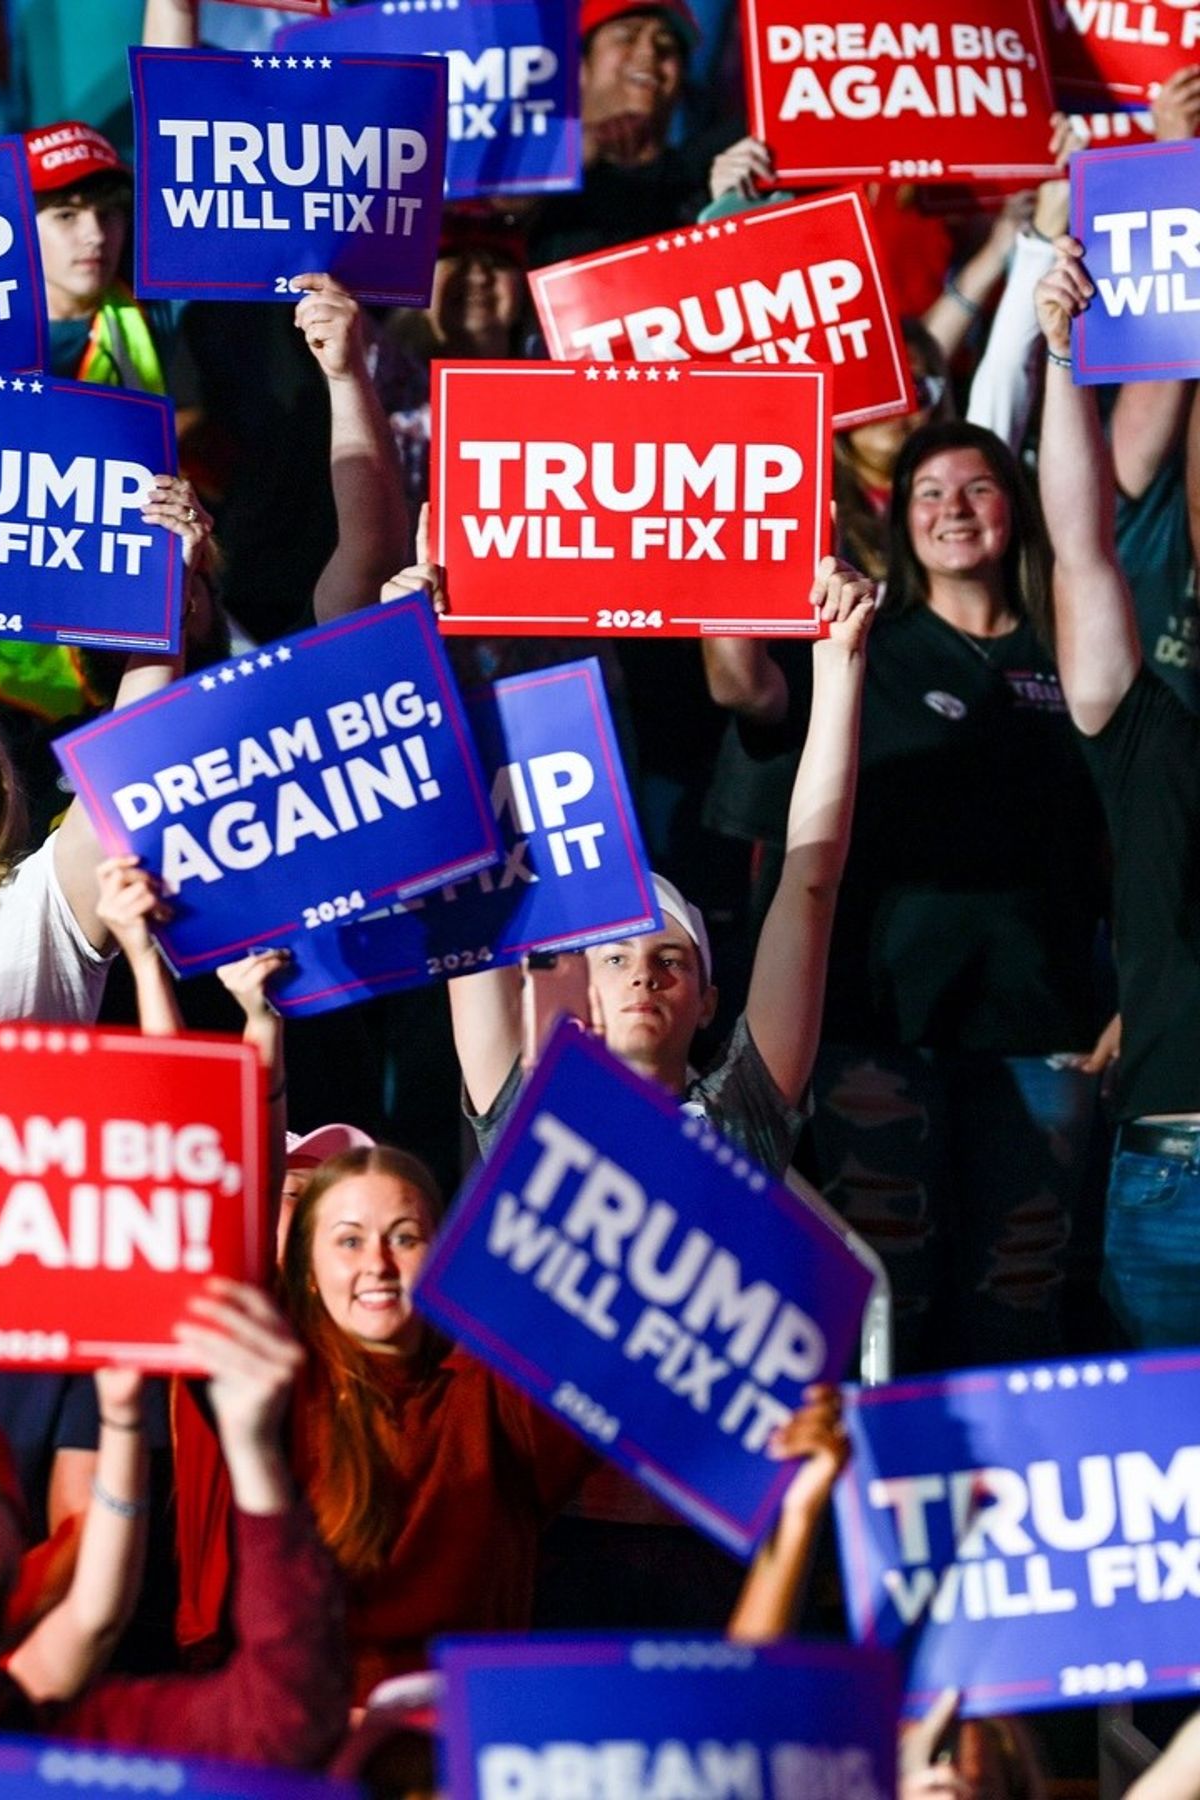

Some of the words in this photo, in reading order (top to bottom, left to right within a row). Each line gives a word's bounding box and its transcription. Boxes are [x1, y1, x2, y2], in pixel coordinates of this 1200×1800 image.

[767, 23, 942, 63] DREAM
[951, 26, 1038, 71] BIG,
[511, 99, 555, 136] IT
[779, 65, 1028, 121] AGAIN!
[158, 119, 428, 190] TRUMP
[888, 158, 943, 178] 2024
[161, 188, 289, 230] WILL
[303, 191, 374, 234] FIX
[385, 198, 422, 236] IT
[570, 259, 863, 362] TRUMP
[1097, 273, 1200, 317] WIL
[825, 318, 872, 365] IT
[459, 441, 803, 513] TRUMP
[101, 532, 153, 576] IT
[461, 516, 614, 560] WILL
[631, 517, 728, 561] FIX
[743, 519, 798, 561] IT
[596, 608, 663, 629] 2024
[112, 717, 321, 832] DREAM
[326, 680, 444, 752] BIG,
[158, 734, 442, 896] AGAIN!
[547, 822, 605, 877] IT
[302, 890, 366, 929] 2024
[426, 946, 493, 976] 2024
[100, 1120, 242, 1197] BIG,
[530, 1111, 828, 1387] TRUMP
[486, 1191, 621, 1341] WILL
[622, 1305, 731, 1412] FIX
[718, 1385, 795, 1452] IT
[868, 1444, 1200, 1565] TRUM
[883, 1554, 1078, 1625] WILL
[1087, 1538, 1200, 1608] FIX
